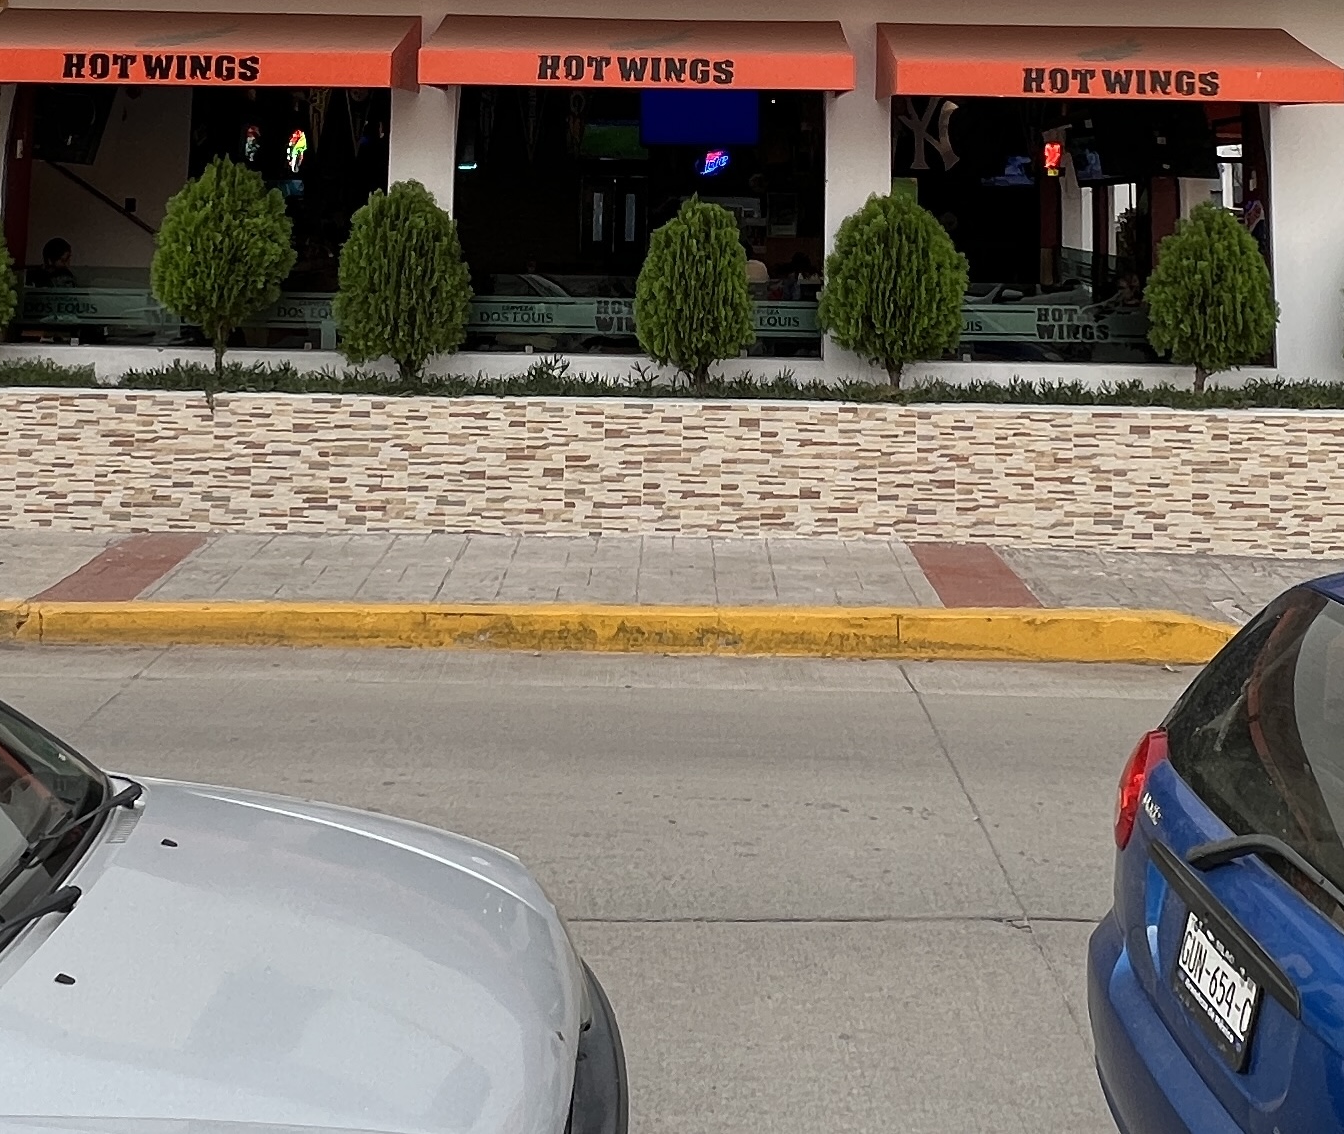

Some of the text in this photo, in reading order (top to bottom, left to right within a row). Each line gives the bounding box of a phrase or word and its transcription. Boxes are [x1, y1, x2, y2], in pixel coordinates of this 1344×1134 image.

[62, 53, 260, 81] HOT WINGS
[537, 55, 734, 84] HOT WINGS
[1022, 67, 1220, 96] HOT WINGS
[57, 302, 98, 314] EQUIS
[1037, 308, 1078, 322] HOT
[480, 312, 553, 323] DOS EQUIS
[1037, 324, 1109, 340] WINGS
